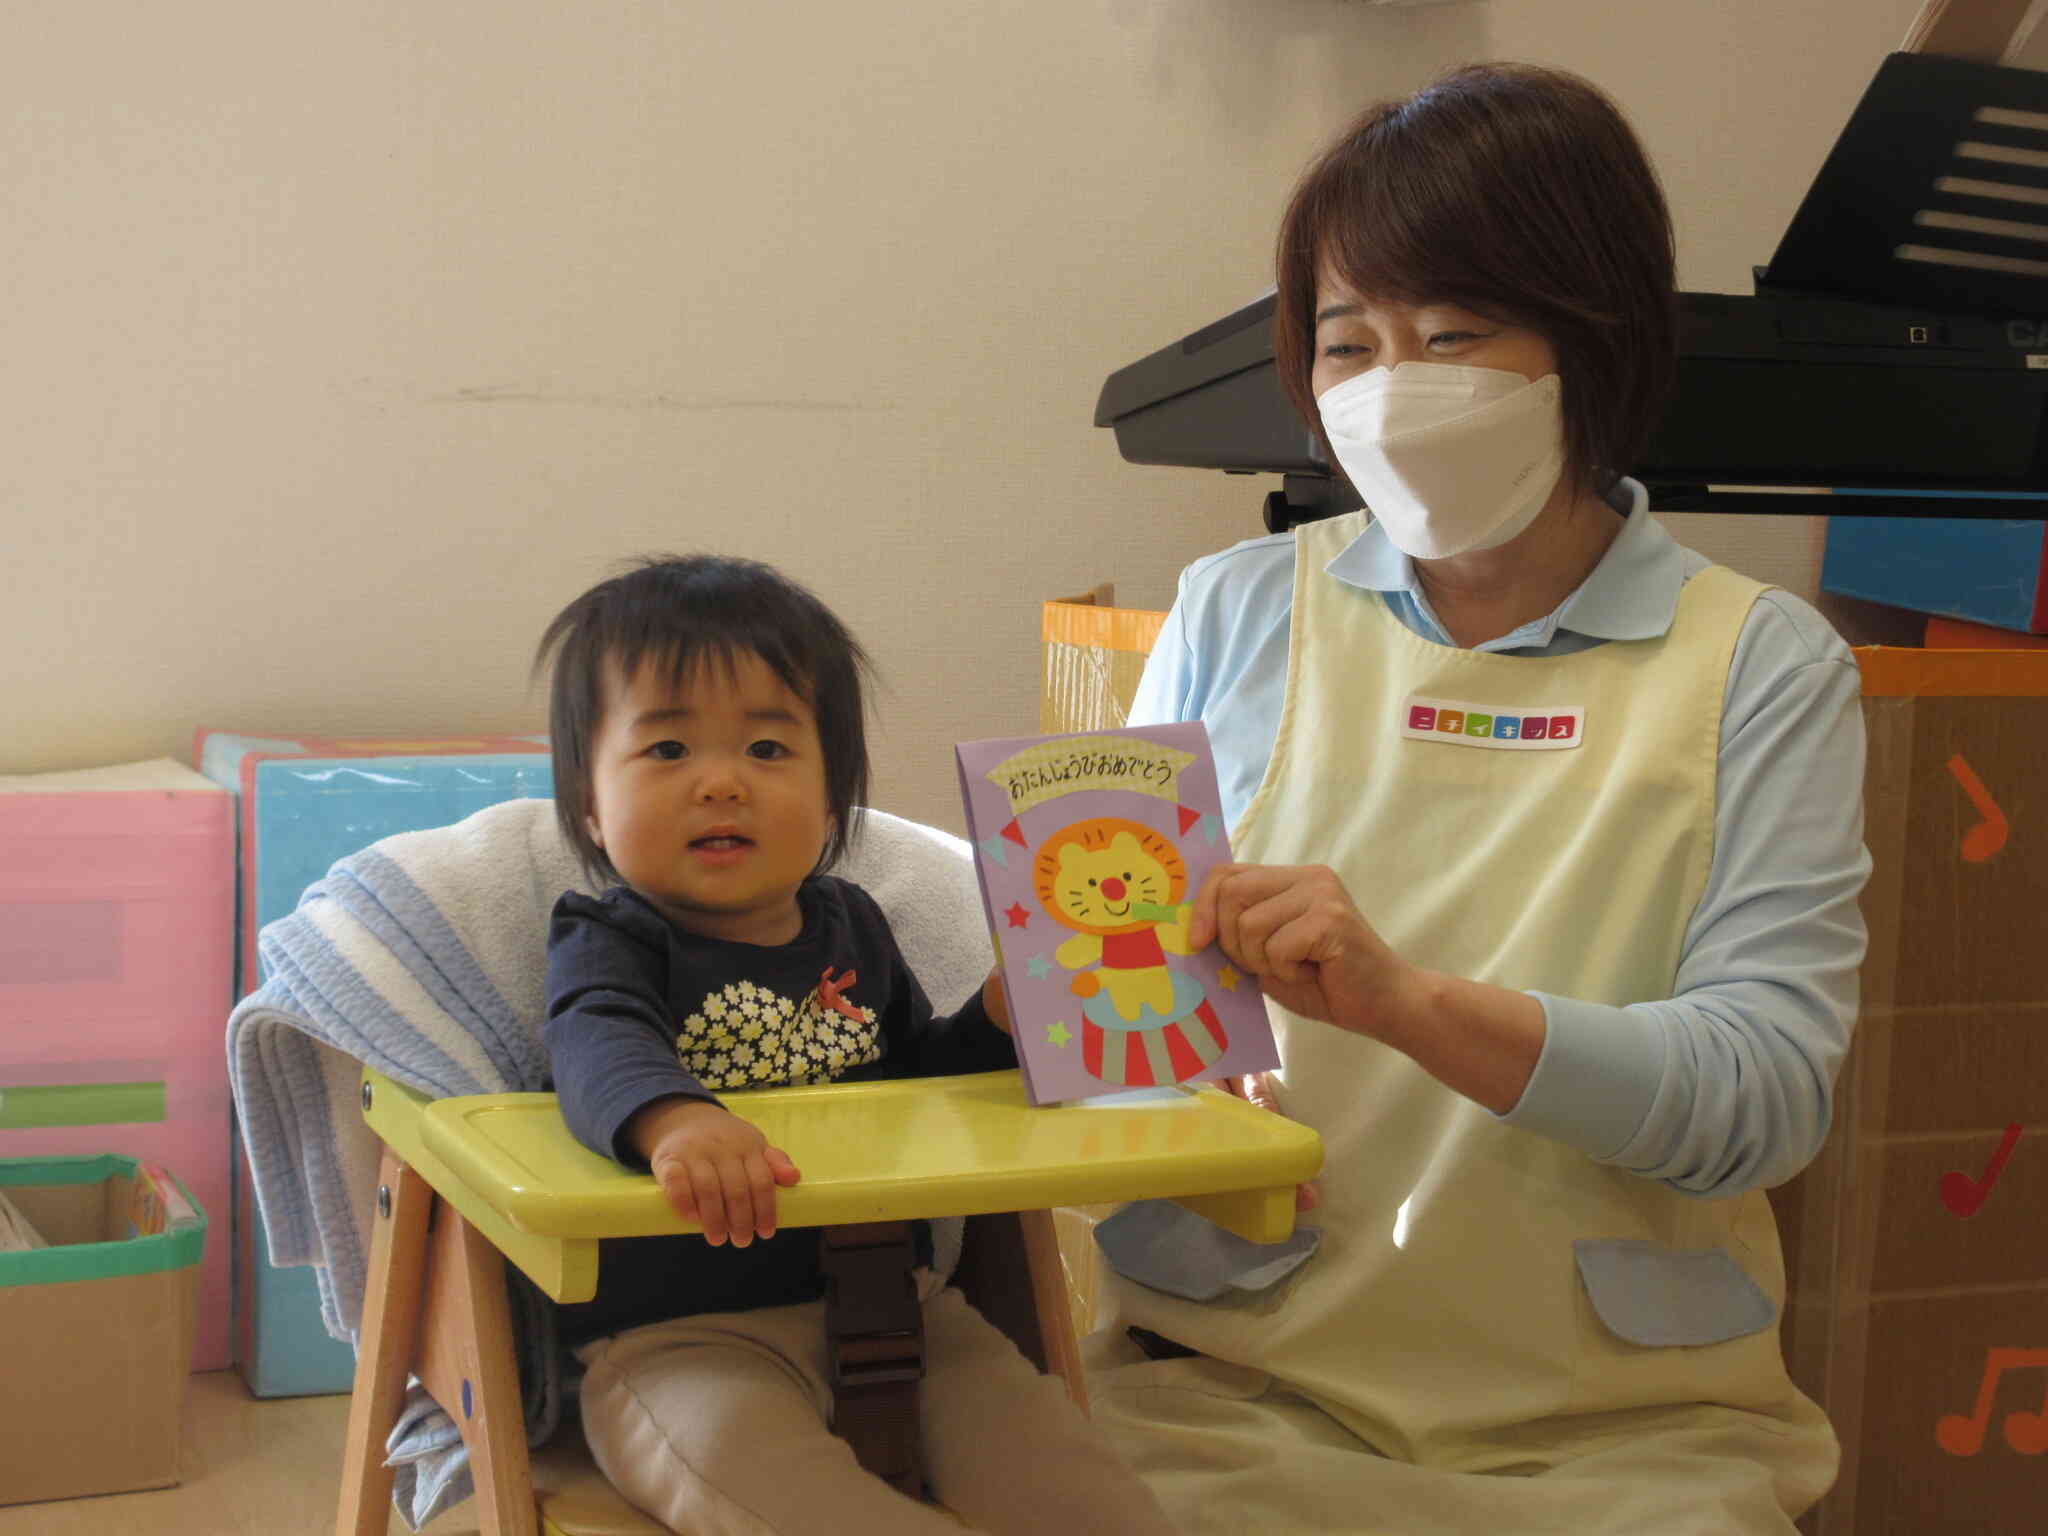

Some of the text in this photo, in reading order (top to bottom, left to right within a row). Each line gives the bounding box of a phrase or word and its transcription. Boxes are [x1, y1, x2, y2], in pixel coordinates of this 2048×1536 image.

[1008, 752, 1173, 800] おたんじょうびおめでとう
